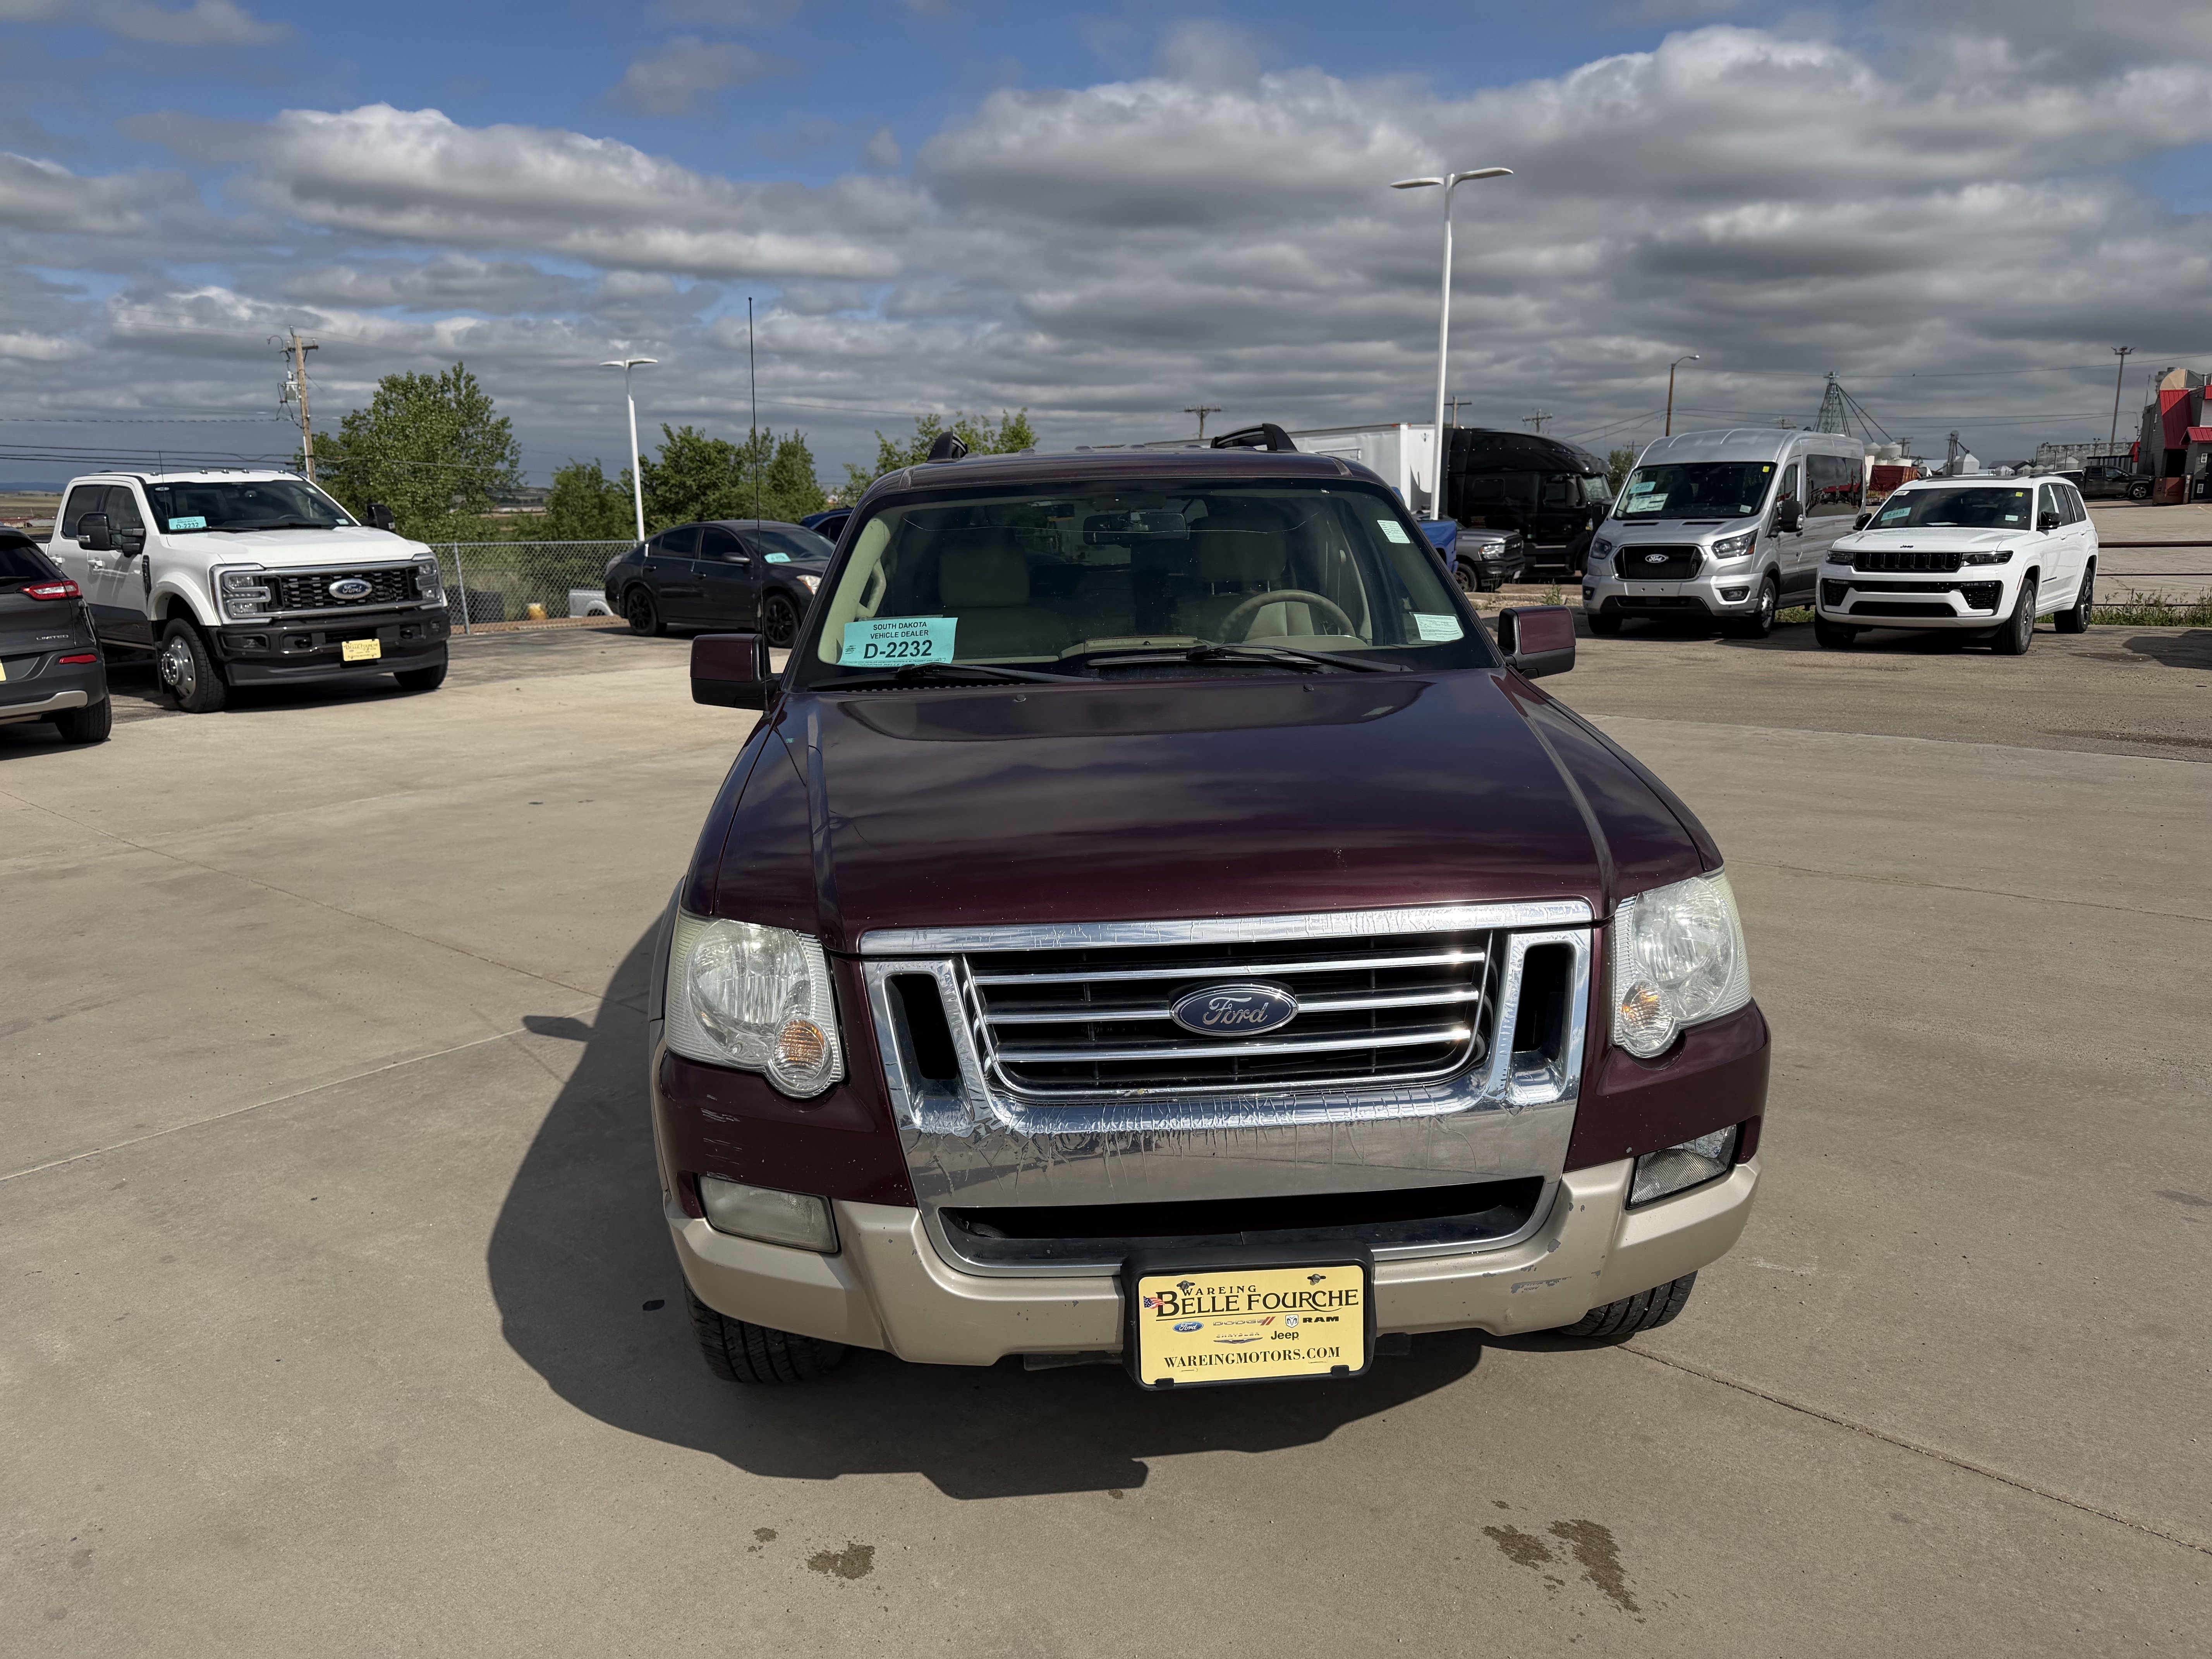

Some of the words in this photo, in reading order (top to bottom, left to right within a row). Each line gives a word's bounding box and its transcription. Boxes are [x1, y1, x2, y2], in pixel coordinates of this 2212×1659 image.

[342, 584, 362, 594] Ford
[864, 640, 932, 659] D-2232
[1202, 996, 1269, 1025] Ford
[1182, 1285, 1257, 1296] WAREING
[1156, 1291, 1240, 1317] BELLE
[1247, 1289, 1359, 1312] FOURCHE
[1179, 1322, 1197, 1331] Ford
[1271, 1331, 1299, 1341] Jeep
[1164, 1346, 1340, 1368] WAREINGMOTORS.COM
